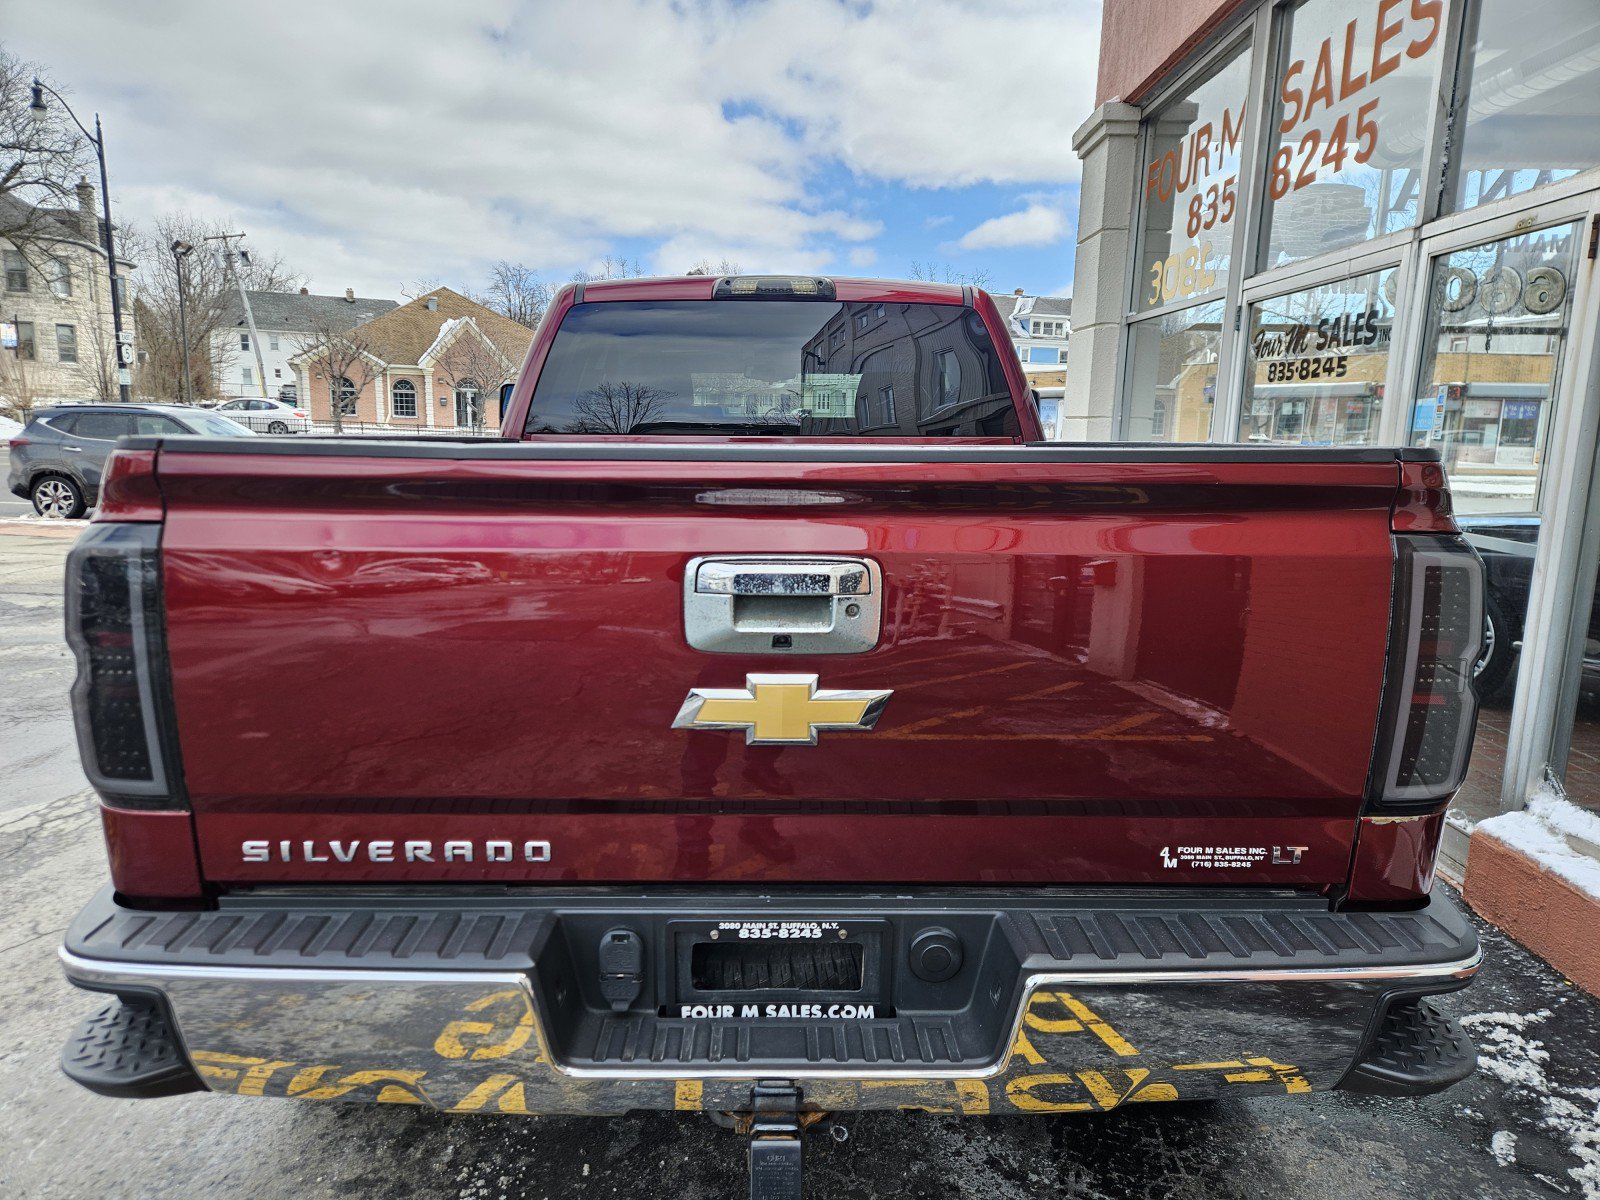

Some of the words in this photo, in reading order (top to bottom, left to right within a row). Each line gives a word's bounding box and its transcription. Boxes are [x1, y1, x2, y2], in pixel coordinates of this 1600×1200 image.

[1279, 0, 1443, 134] SALES
[1187, 174, 1236, 239] 835
[1269, 96, 1380, 201] 8245
[1284, 323, 1310, 355] M
[1316, 309, 1380, 351] SALES
[125, 348, 131, 360] 5
[241, 840, 551, 862] SILVERADO
[1160, 846, 1169, 857] 4
[1178, 846, 1203, 854] FOUR
[1216, 847, 1247, 855] SALES
[1249, 847, 1268, 855] INC.
[1272, 846, 1309, 865] LT
[1164, 858, 1177, 868] M
[1191, 861, 1212, 869] (716)
[718, 922, 741, 930] 3080
[742, 922, 766, 930] MAIN
[821, 922, 839, 930] N.Y.
[738, 928, 823, 939] 835-8245
[681, 1005, 735, 1019] FOUR
[741, 1005, 759, 1019] M
[765, 1004, 875, 1019] SALES.COM
